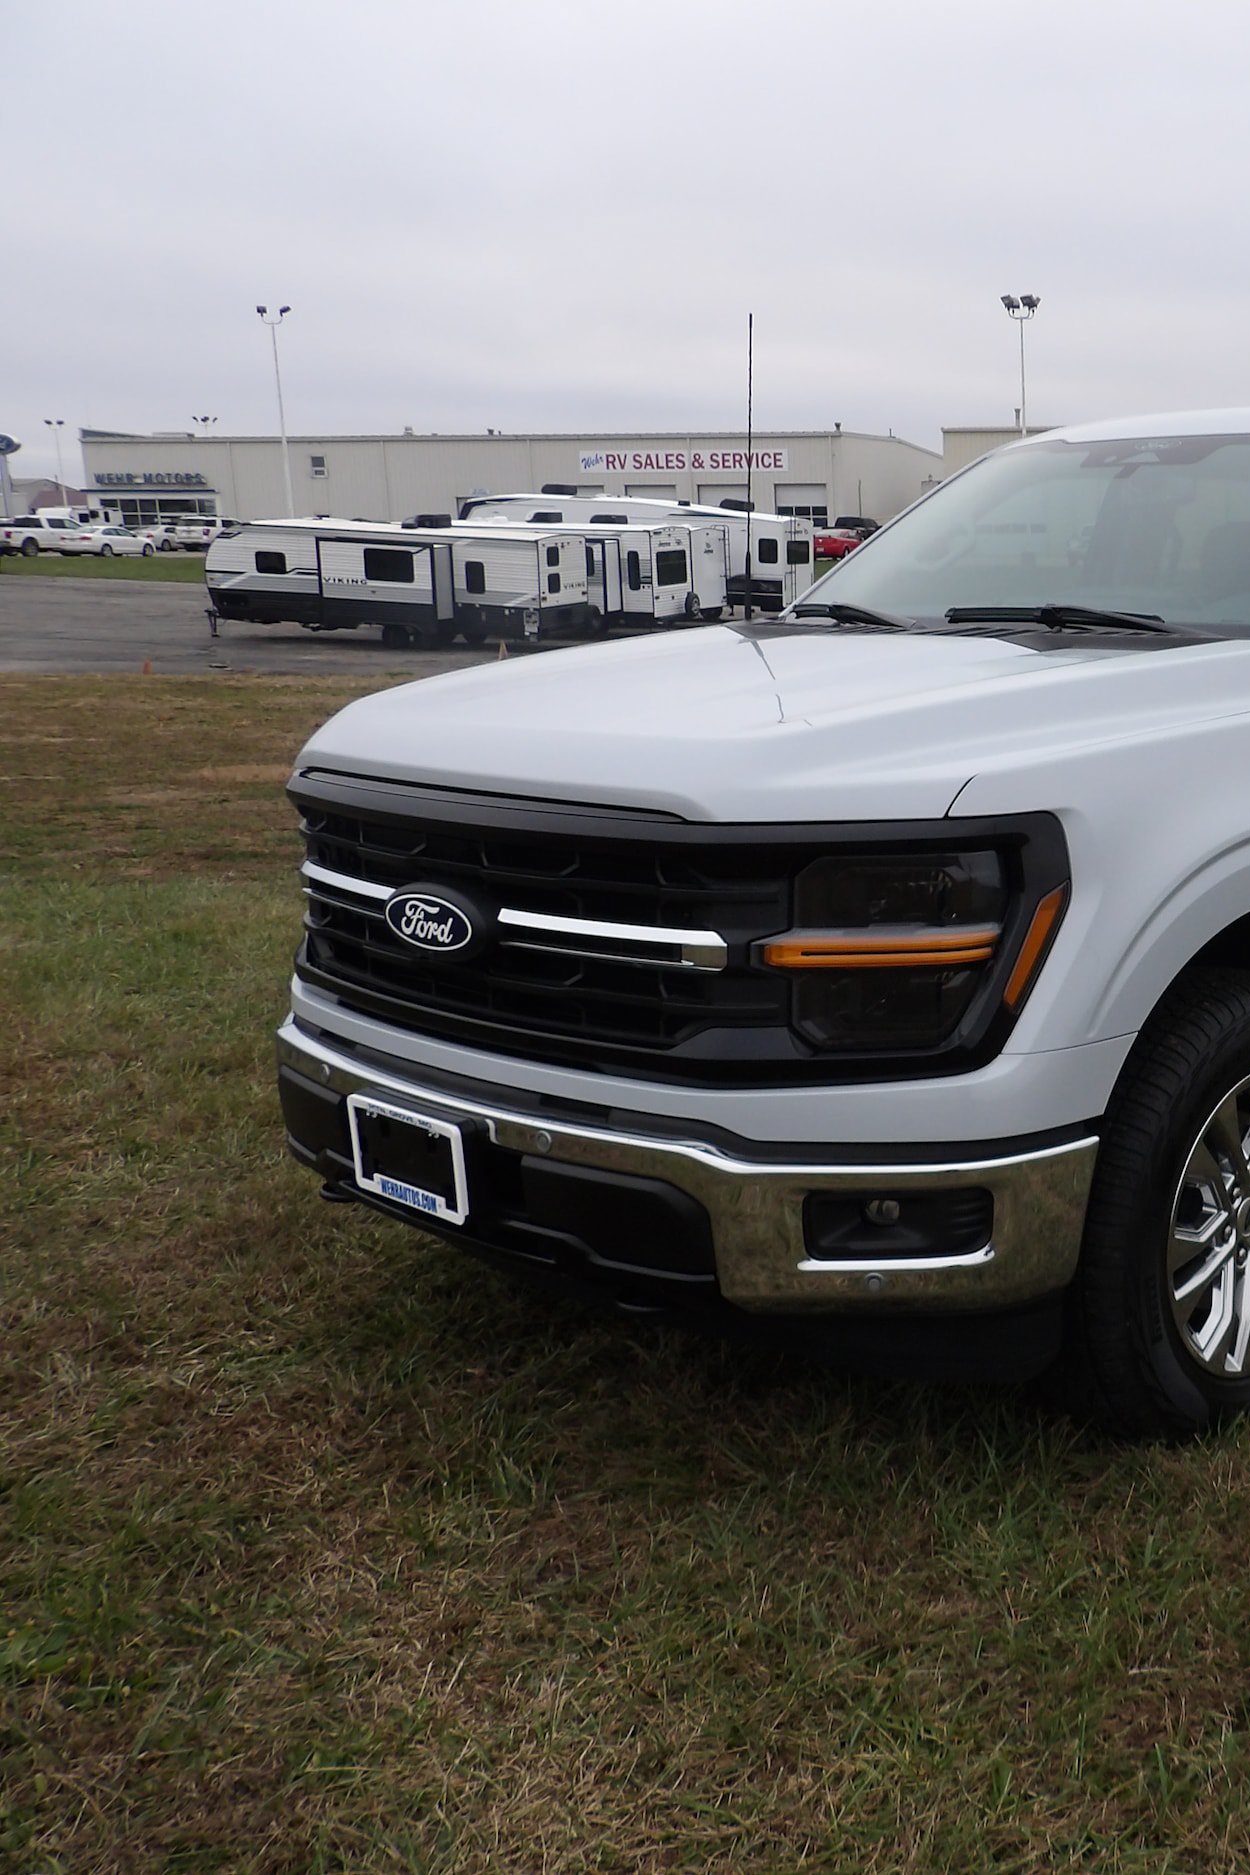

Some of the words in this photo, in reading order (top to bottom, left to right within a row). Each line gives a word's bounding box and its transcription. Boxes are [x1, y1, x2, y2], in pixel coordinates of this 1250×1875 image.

[605, 454, 627, 470] RV
[632, 453, 686, 470] SALES
[691, 453, 705, 469] &
[709, 452, 784, 469] SERVICE
[94, 473, 134, 484] WEHR
[142, 473, 206, 484] MOTORS
[323, 576, 368, 585] VIKING
[401, 900, 453, 944] Ford
